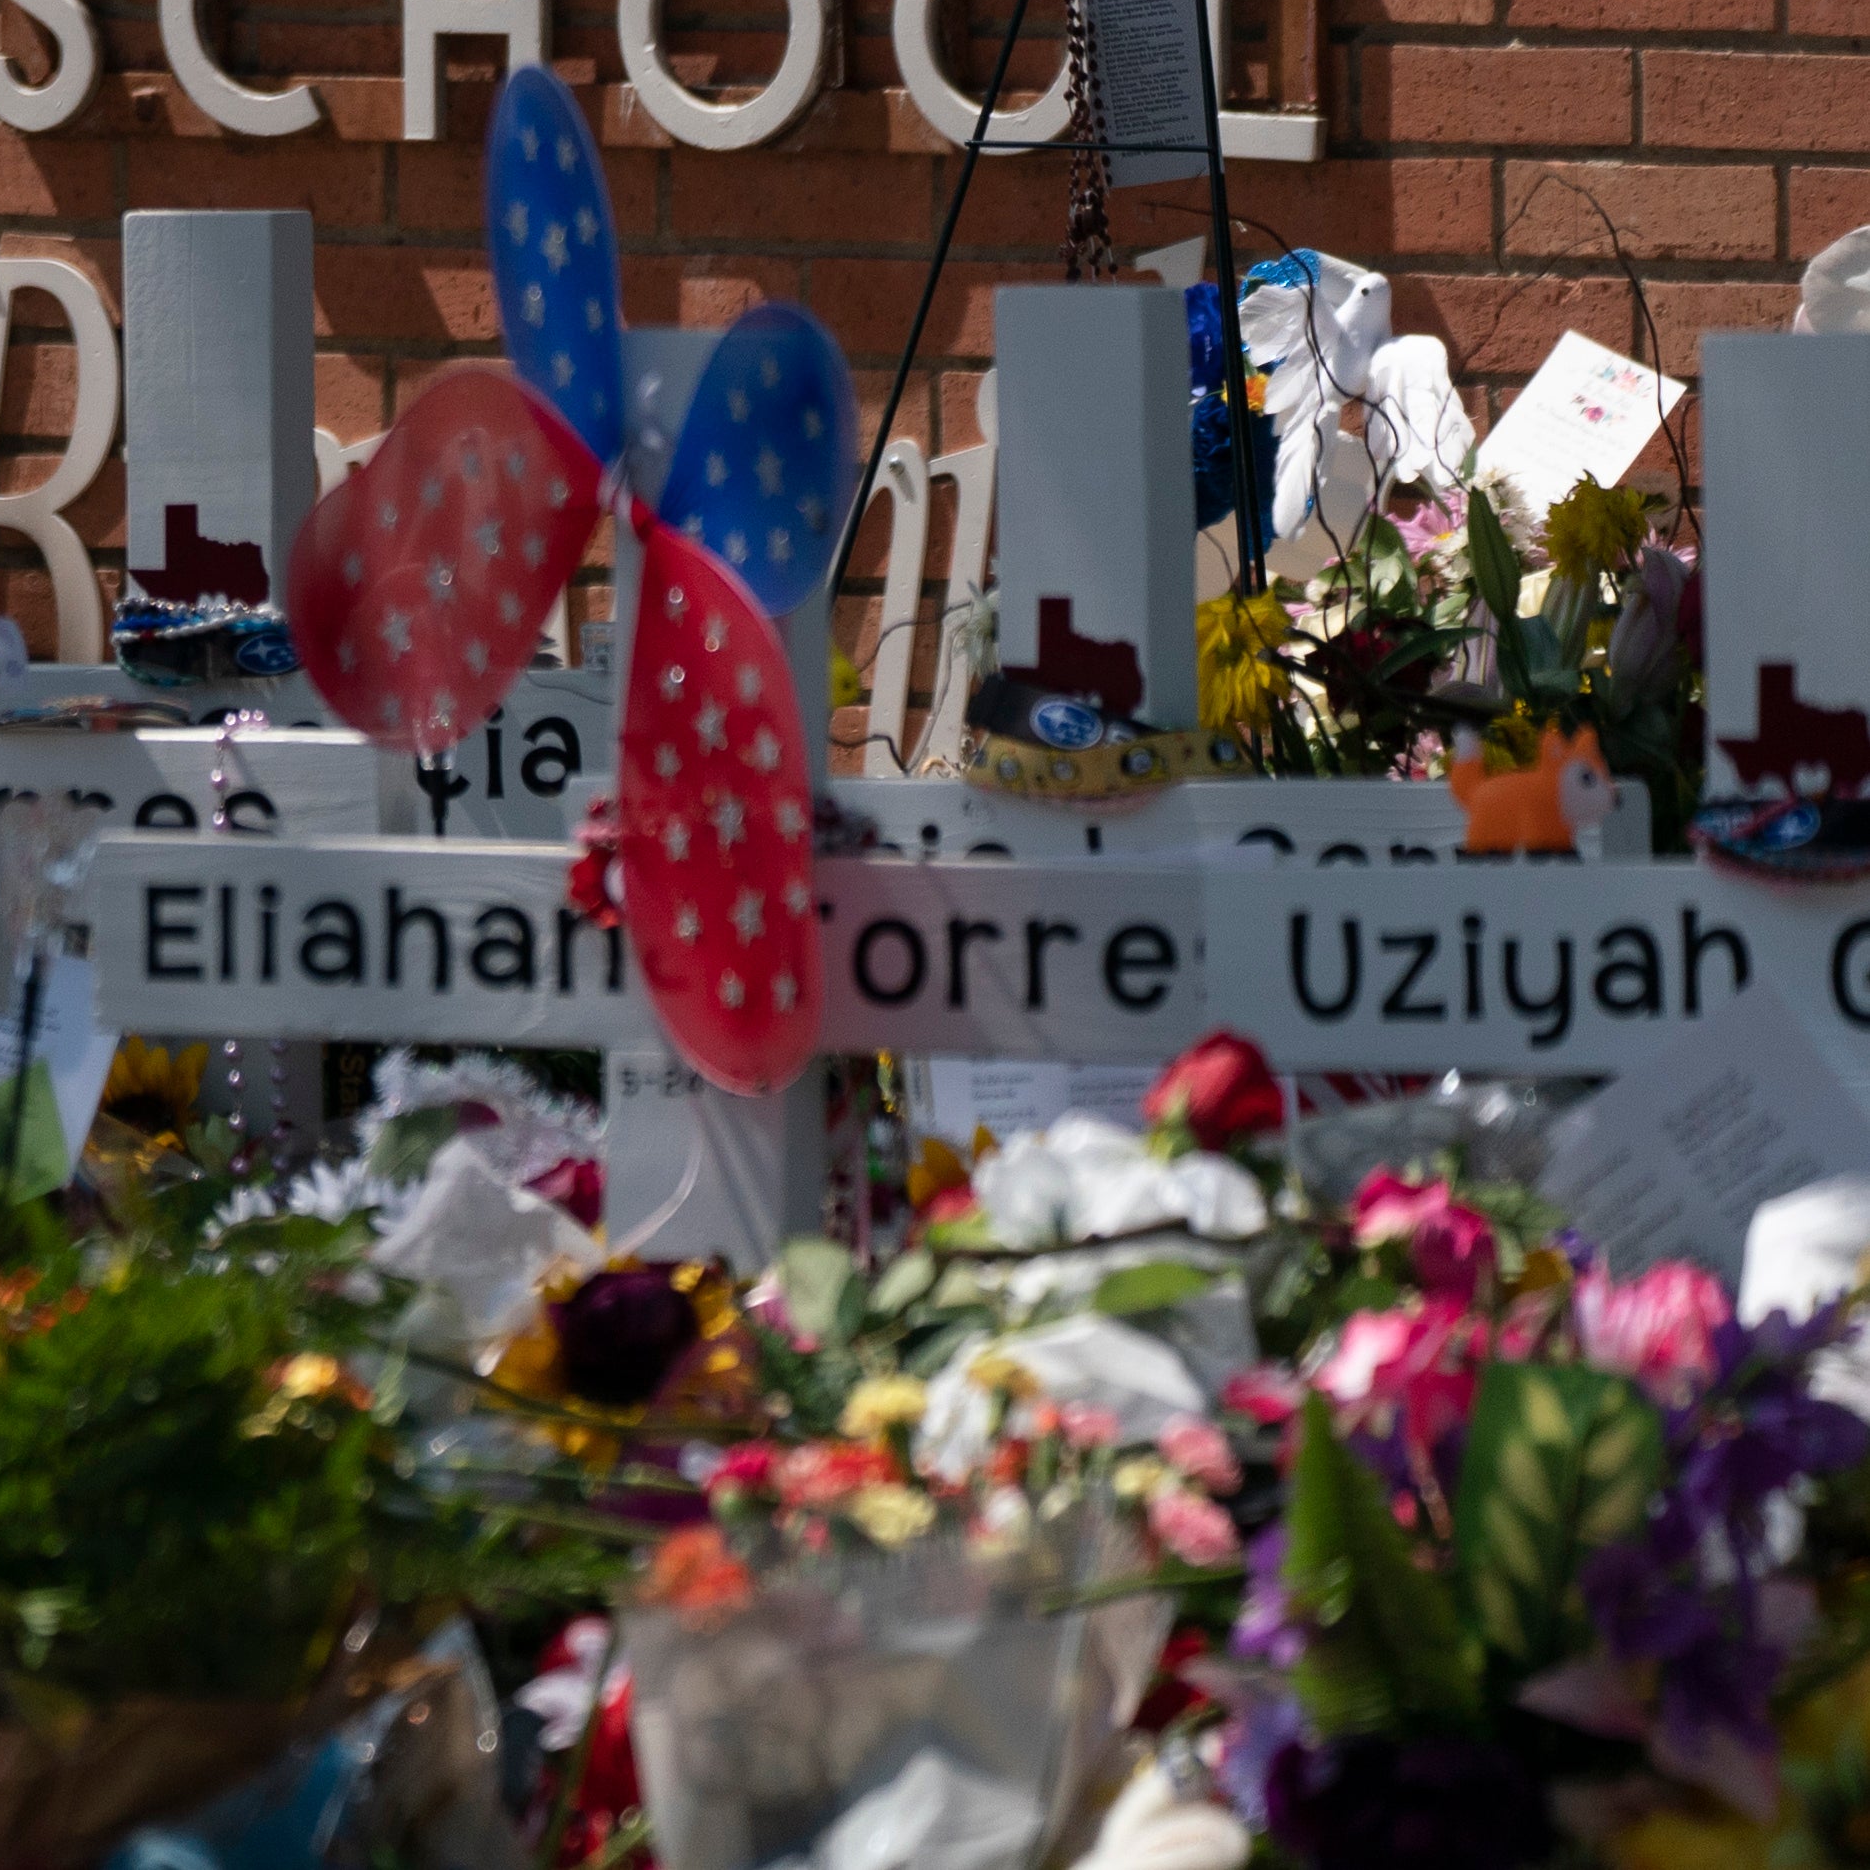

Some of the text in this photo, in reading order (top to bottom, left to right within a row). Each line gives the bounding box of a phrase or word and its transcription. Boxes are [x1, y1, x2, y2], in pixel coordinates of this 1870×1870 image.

[143, 881, 1202, 1012] Eliahan orre
[1289, 904, 1752, 1050] Uziyah
